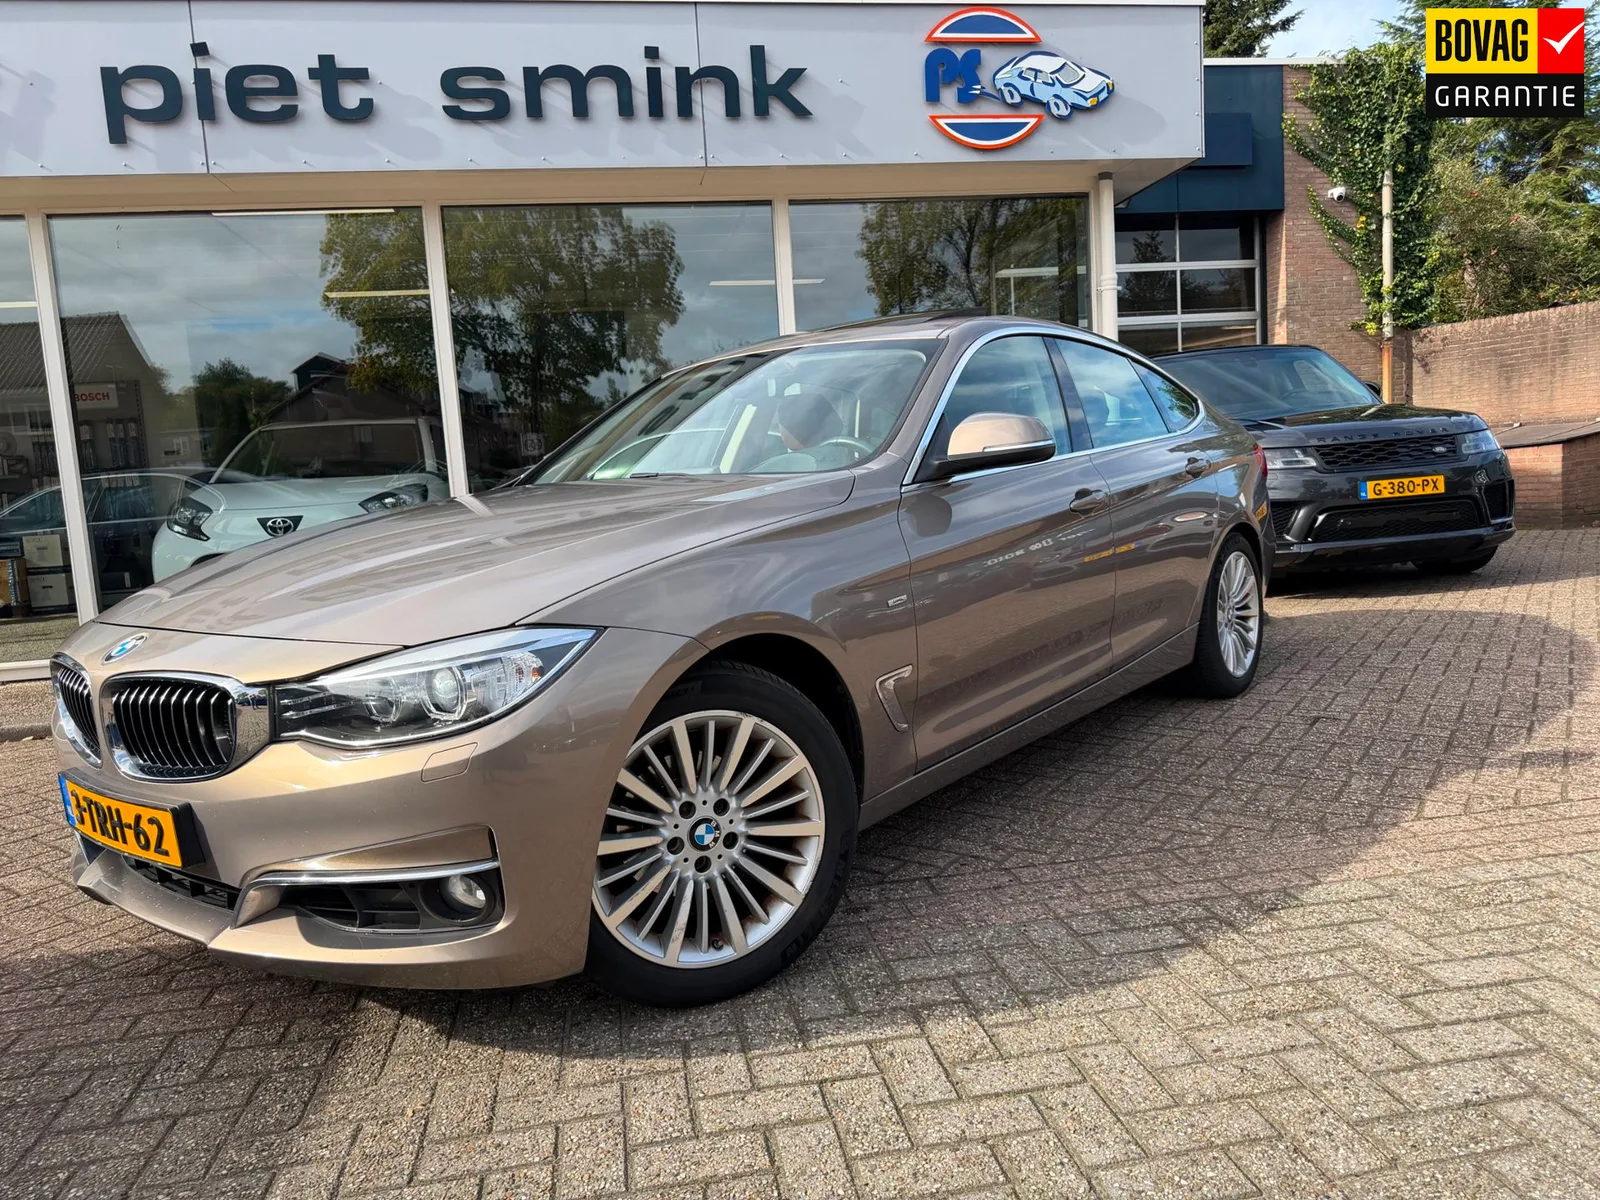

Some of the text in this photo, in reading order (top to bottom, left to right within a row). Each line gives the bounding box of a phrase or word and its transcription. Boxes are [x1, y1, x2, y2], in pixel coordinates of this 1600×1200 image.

[100, 41, 813, 145] piet smink
[924, 47, 982, 104] PS
[74, 391, 110, 402] BOSCH
[1316, 427, 1449, 443] RANGE ROVER
[1372, 477, 1440, 496] G-380-PX
[71, 789, 171, 857] 3-TRH-62
